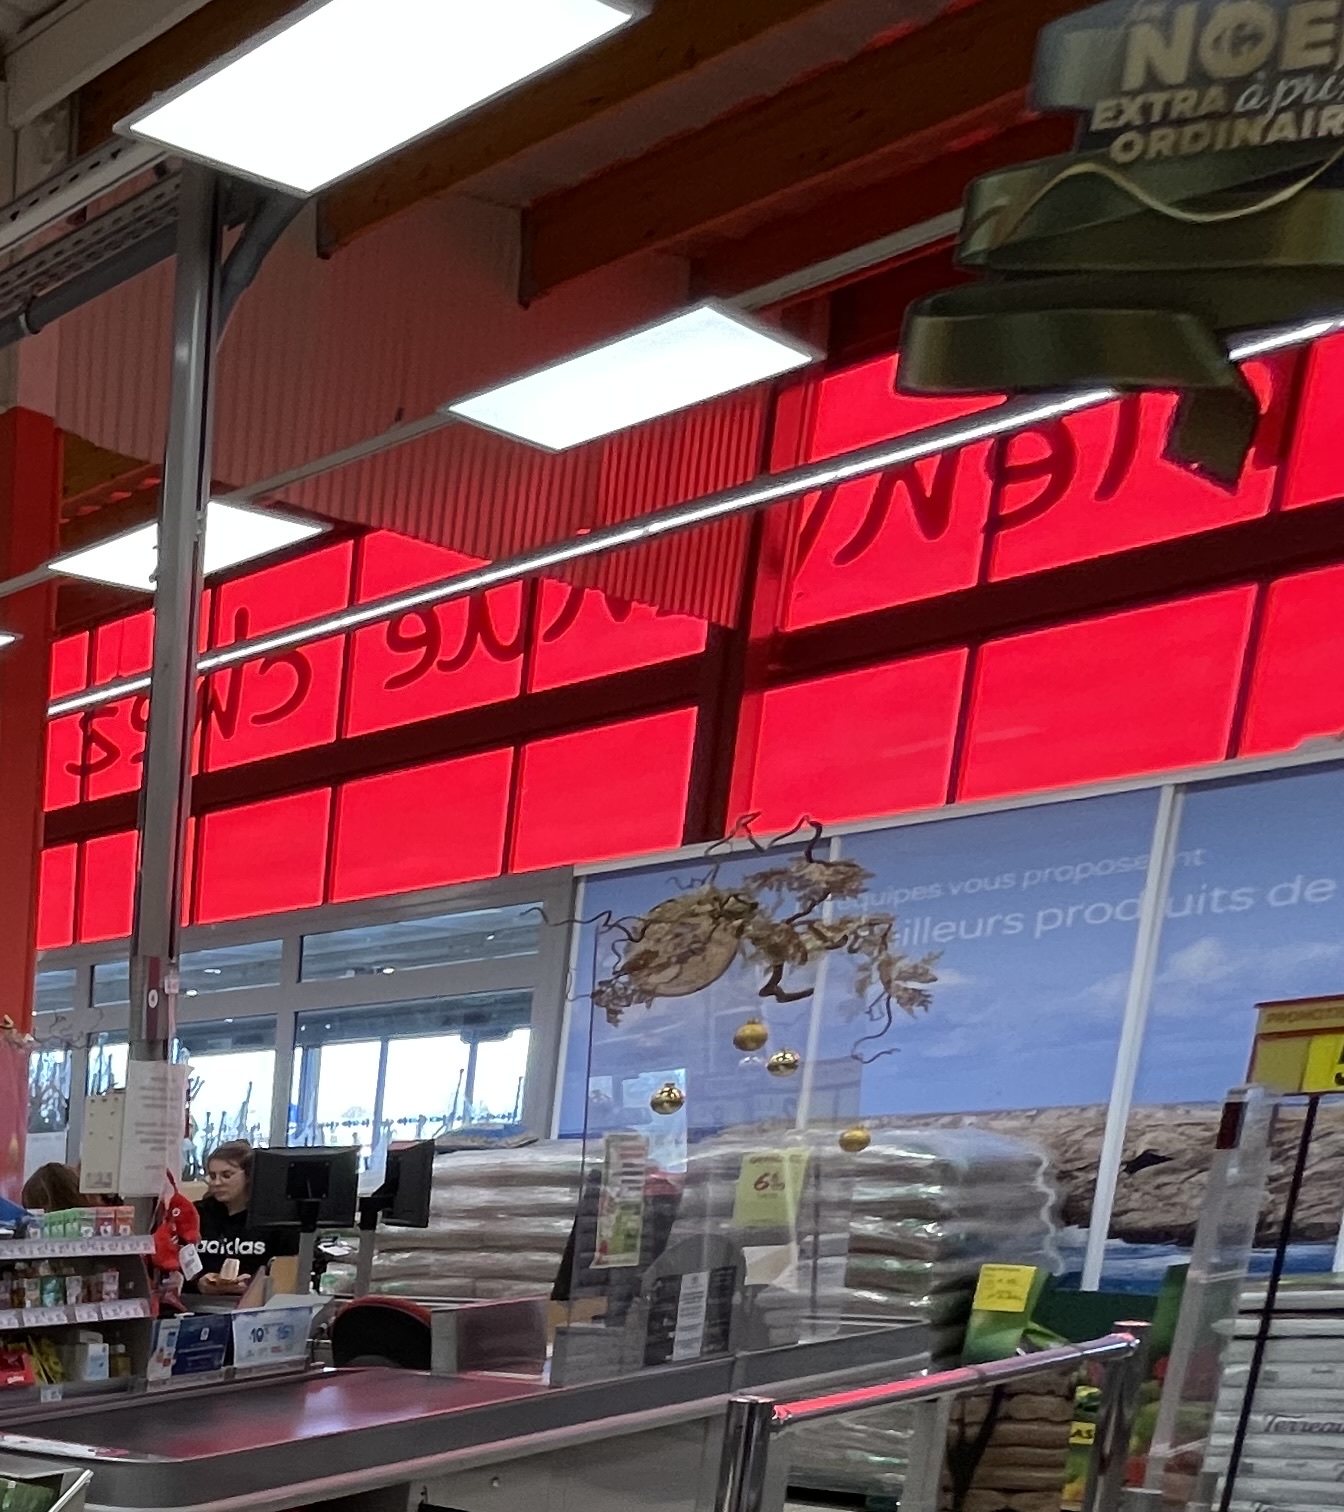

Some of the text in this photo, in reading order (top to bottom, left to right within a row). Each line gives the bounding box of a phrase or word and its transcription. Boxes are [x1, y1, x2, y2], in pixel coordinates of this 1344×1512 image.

[1091, 86, 1227, 131] EXTRA
[948, 873, 1016, 895] vous
[1267, 873, 1337, 907] de
[196, 1237, 266, 1256] adidas
